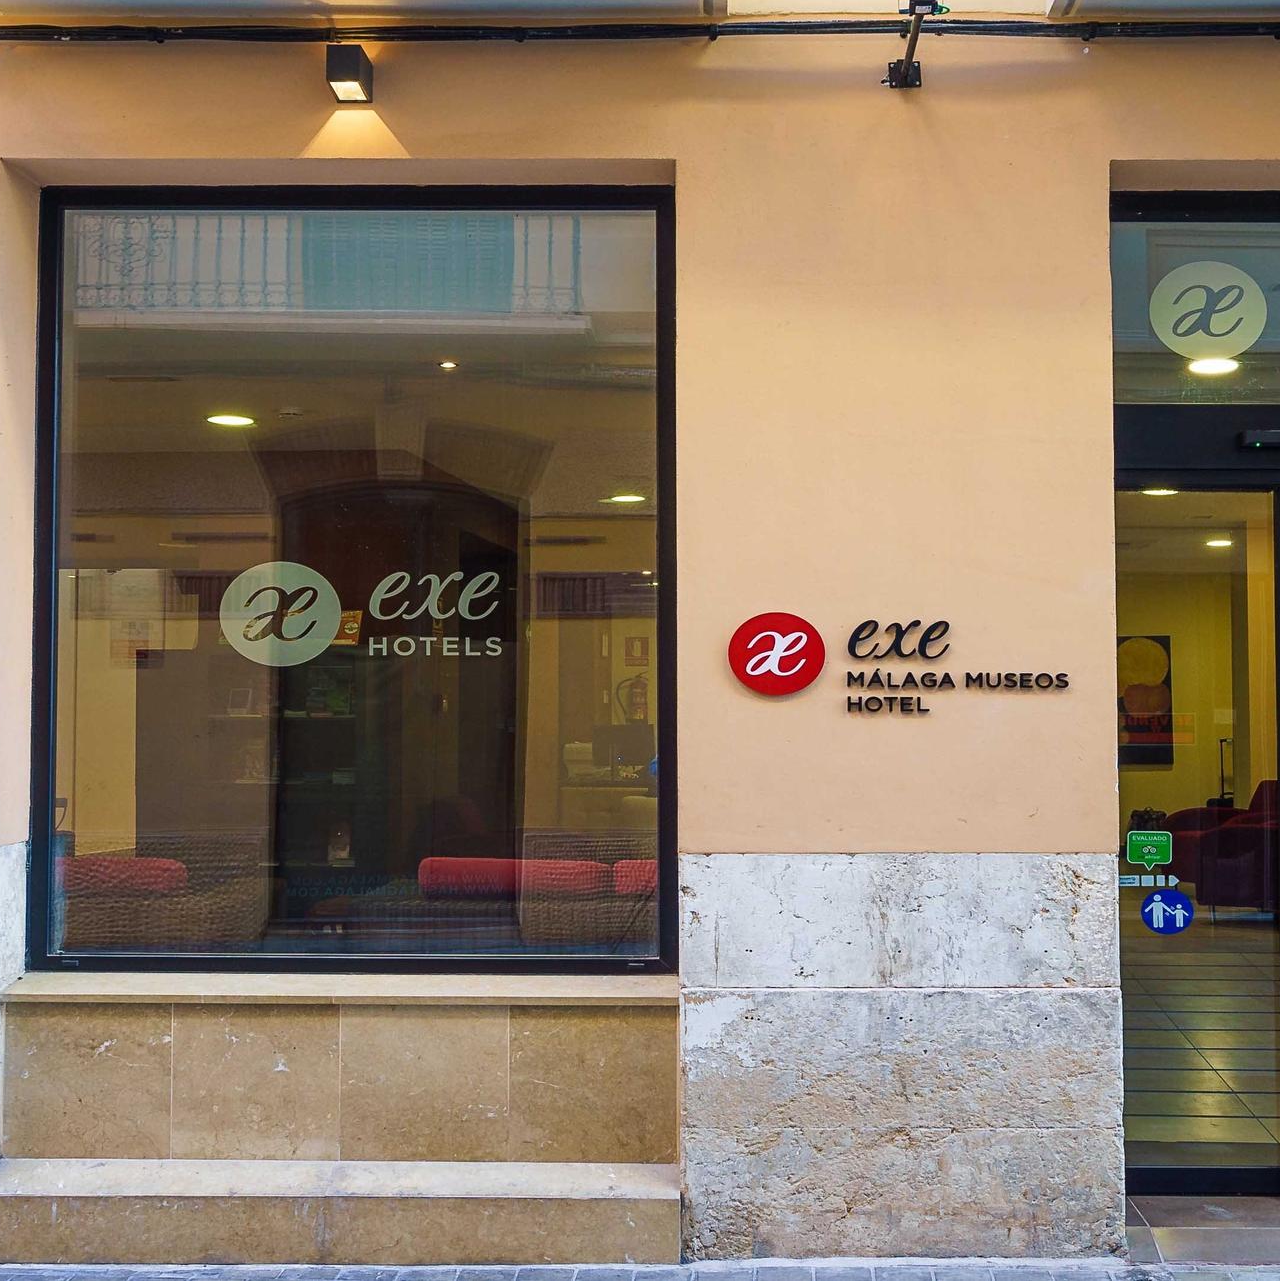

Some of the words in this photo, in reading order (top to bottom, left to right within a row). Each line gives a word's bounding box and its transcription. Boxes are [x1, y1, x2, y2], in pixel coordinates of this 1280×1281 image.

[369, 571, 500, 621] exe
[368, 635, 503, 657] HOTELS
[847, 618, 952, 660] exe
[846, 668, 957, 690] MÁLAGA
[964, 671, 1070, 690] MUSEOS
[846, 695, 932, 714] HOTEL
